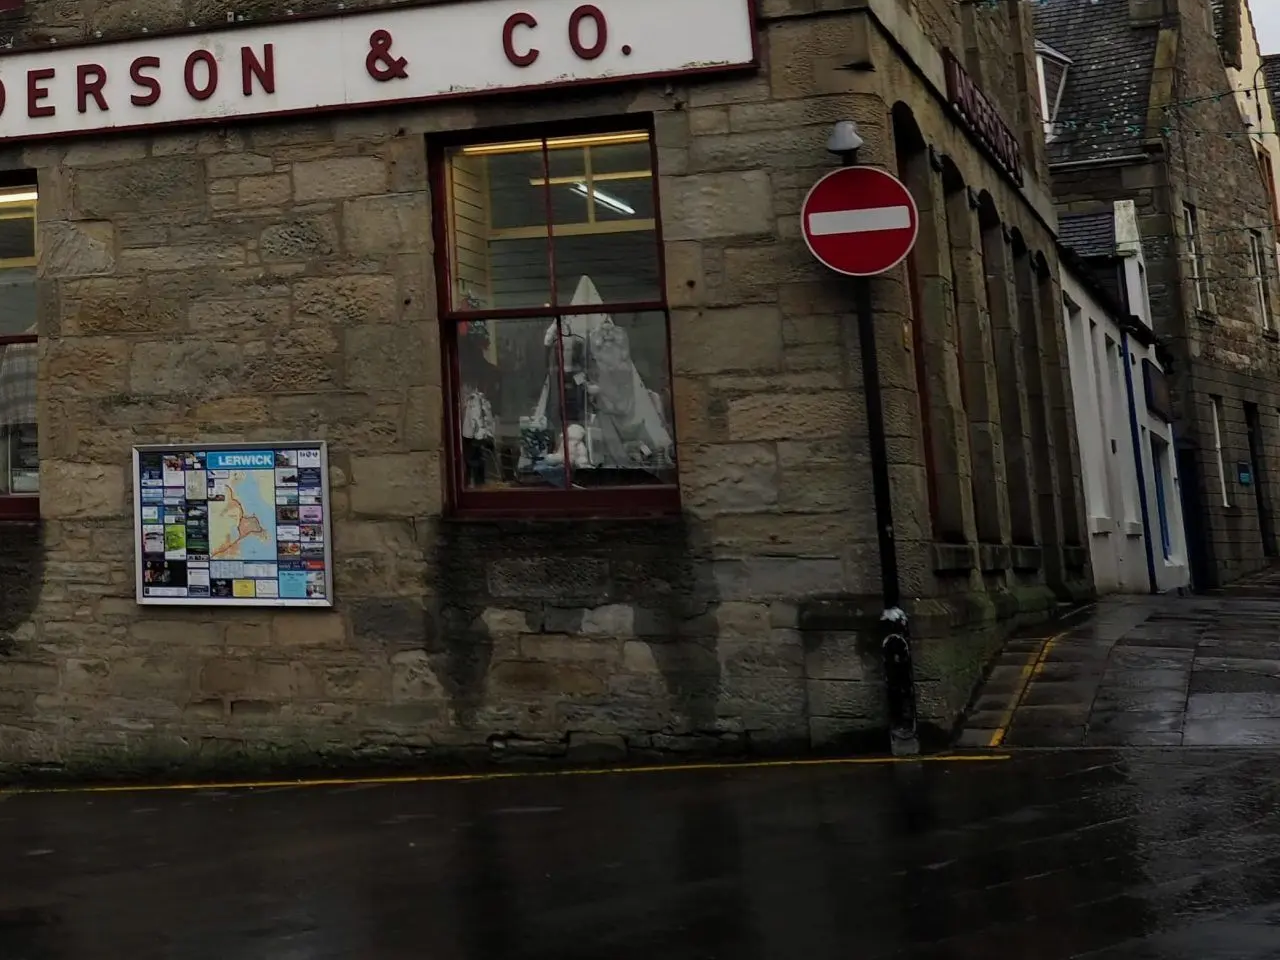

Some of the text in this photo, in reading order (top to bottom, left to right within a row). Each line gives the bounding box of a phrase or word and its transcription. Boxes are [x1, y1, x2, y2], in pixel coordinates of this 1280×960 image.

[366, 29, 408, 83] &
[501, 3, 632, 68] CO.
[218, 455, 273, 466] LERWICK
